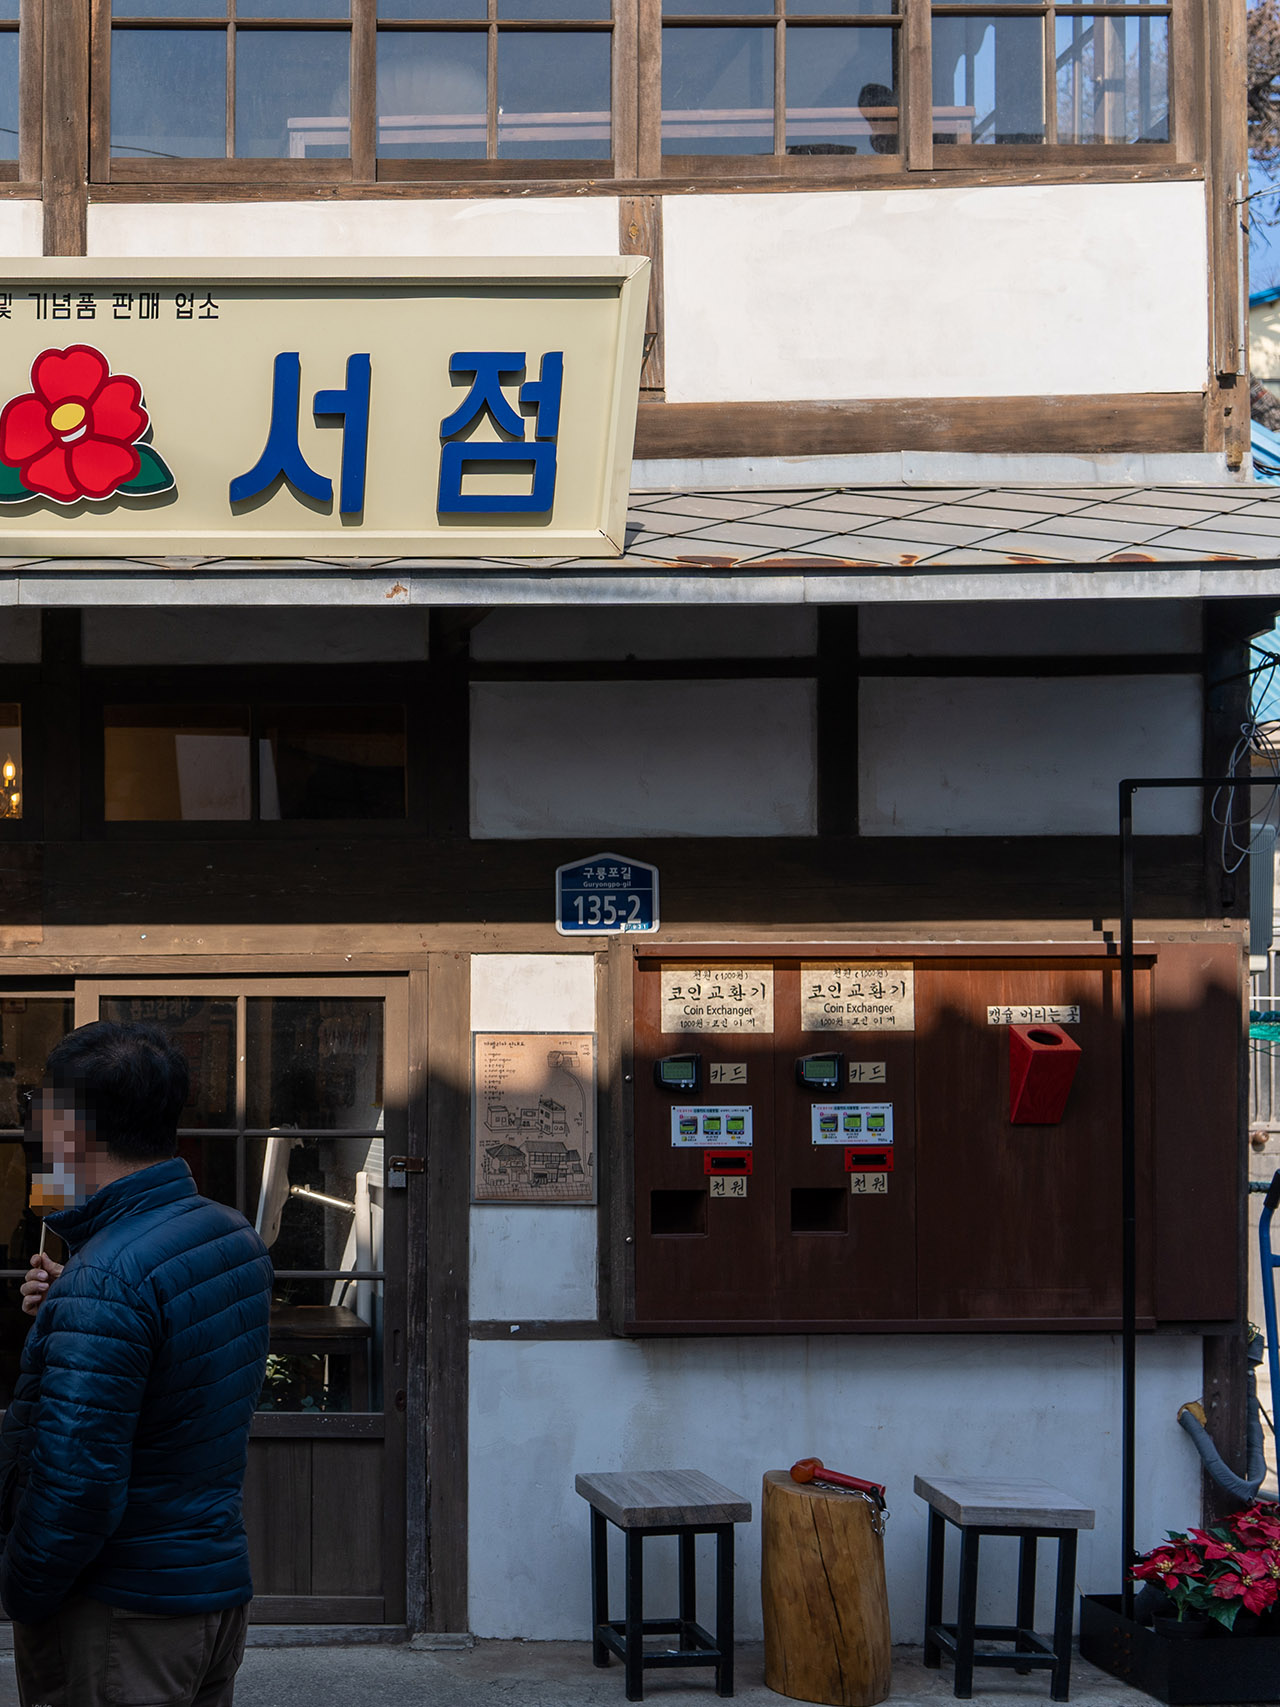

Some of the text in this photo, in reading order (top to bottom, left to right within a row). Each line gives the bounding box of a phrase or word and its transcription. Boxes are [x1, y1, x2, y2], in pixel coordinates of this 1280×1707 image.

[28, 293, 97, 320] 기념품
[112, 293, 160, 319] 판매
[175, 293, 219, 319] 업소
[229, 351, 564, 513] 서점
[583, 867, 631, 880] 구룡포길
[573, 895, 641, 925] 135-2
[684, 1005, 753, 1016] Coin Exchanger
[824, 1003, 893, 1014] Coin Exchanger
[989, 1007, 1079, 1024] 캡슐 버리는 곳
[711, 1065, 746, 1082] 카드
[850, 1064, 885, 1081] 카드
[713, 1178, 745, 1196] 천원
[854, 1175, 886, 1193] 천원
